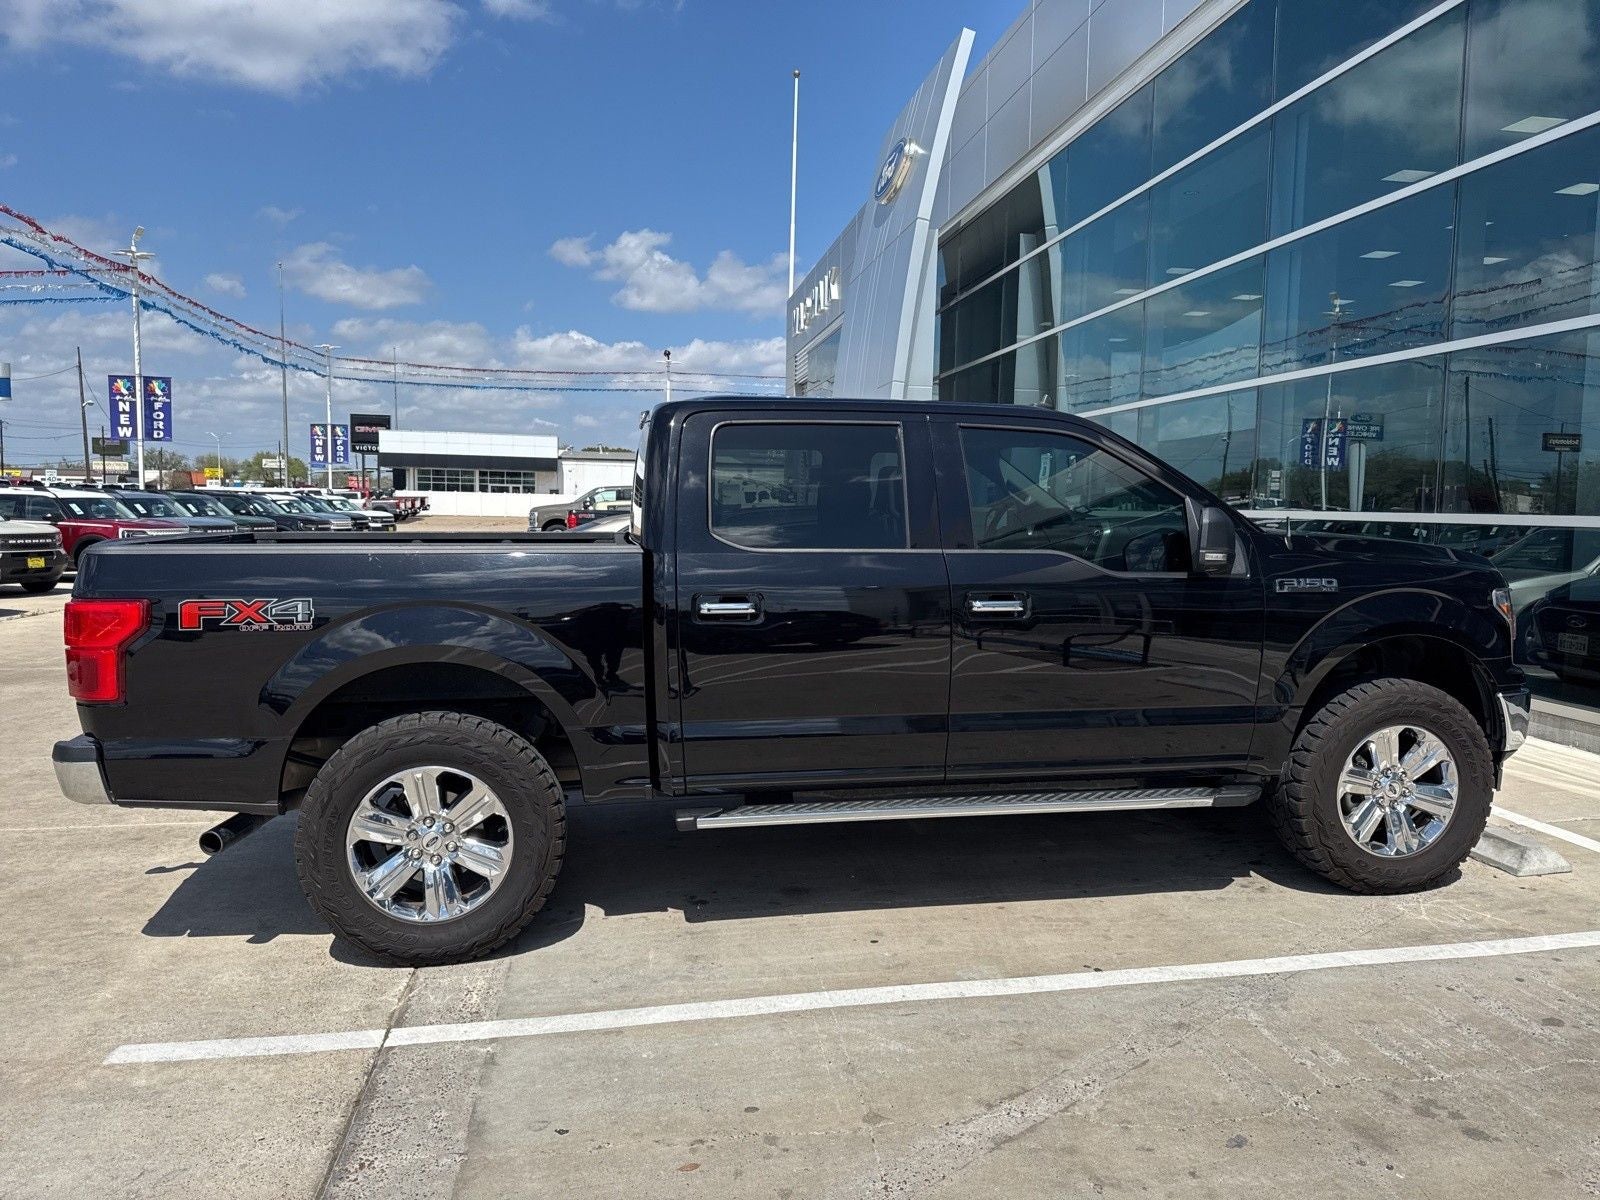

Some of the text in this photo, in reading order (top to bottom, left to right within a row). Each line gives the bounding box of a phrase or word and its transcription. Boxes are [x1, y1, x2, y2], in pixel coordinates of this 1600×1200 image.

[117, 401, 133, 438] NEW
[152, 402, 165, 439] FORD
[314, 439, 325, 462] NEW
[336, 440, 344, 463] FORD
[178, 598, 315, 631] FX4
